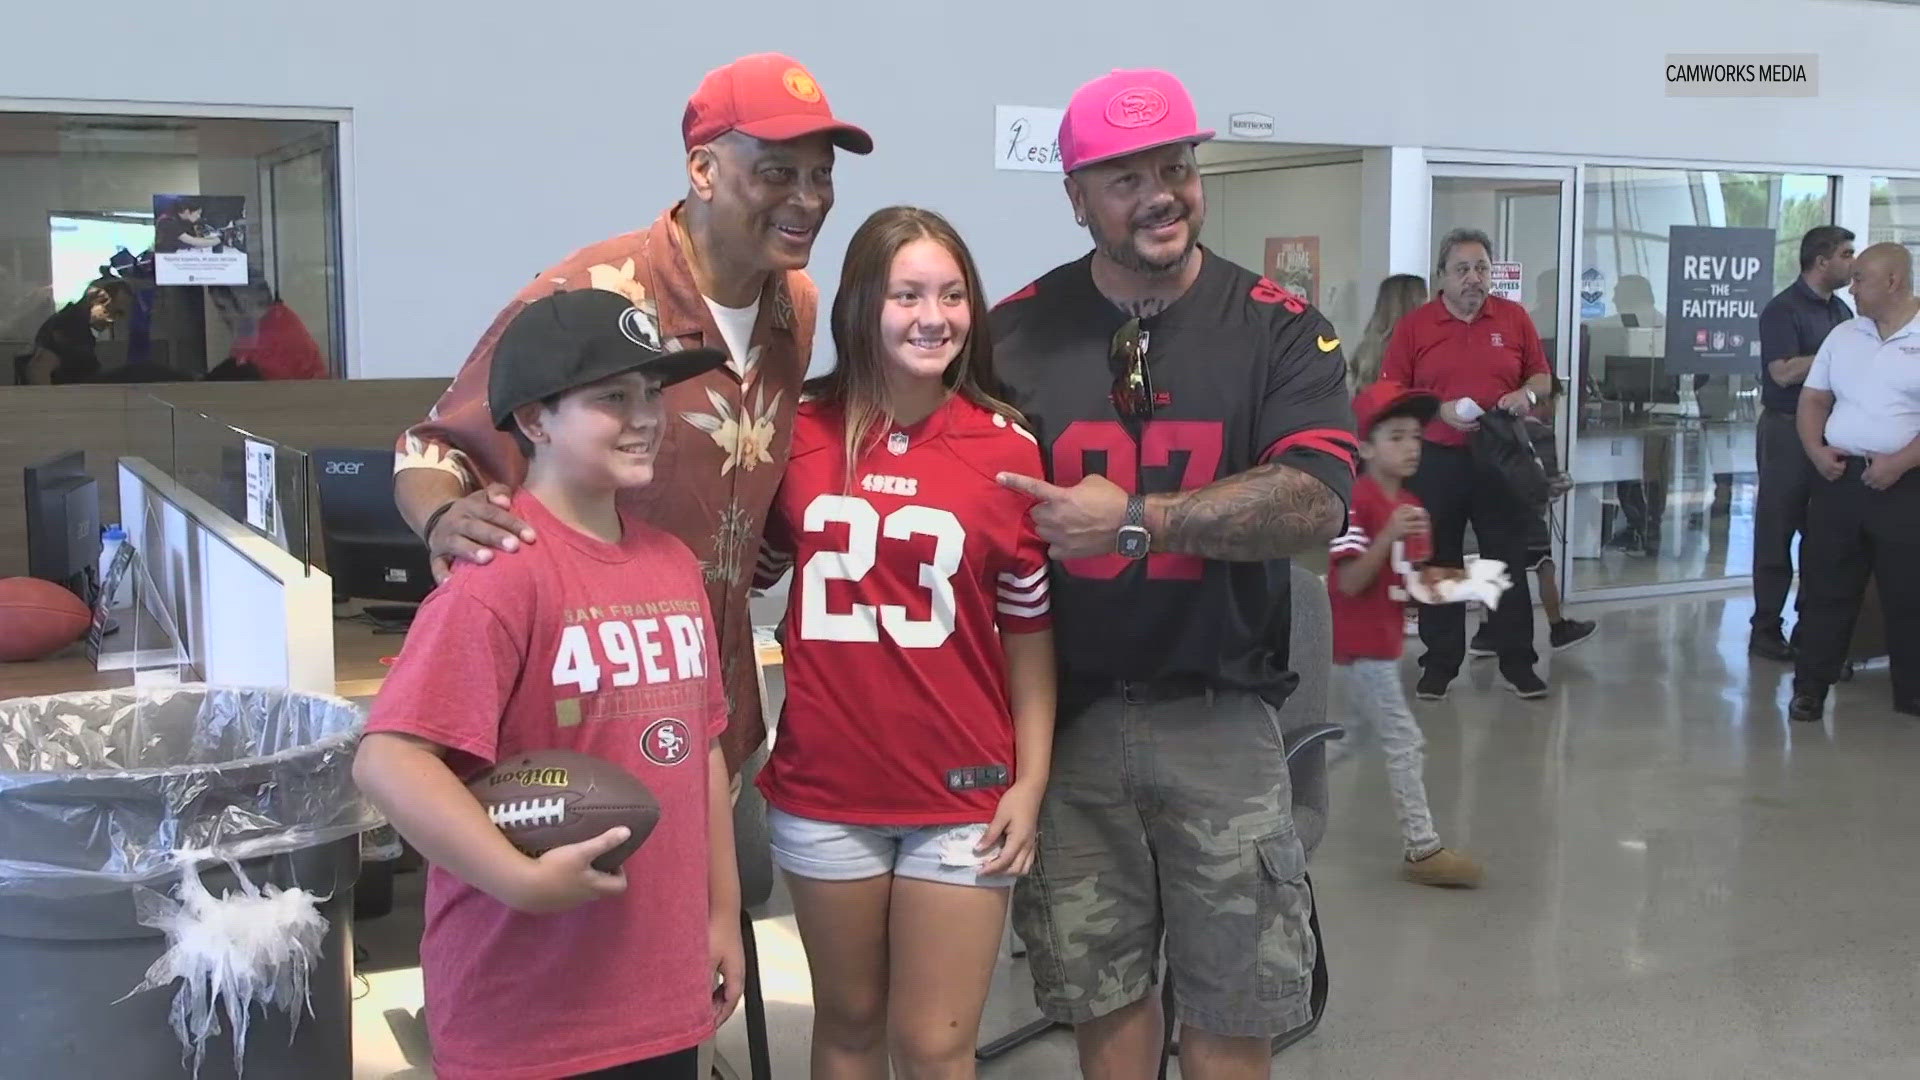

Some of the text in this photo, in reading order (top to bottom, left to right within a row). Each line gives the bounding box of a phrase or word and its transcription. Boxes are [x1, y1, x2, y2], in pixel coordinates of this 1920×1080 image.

[1233, 120, 1273, 130] RESTROOM
[1683, 255, 1761, 281] REV UP
[1491, 281, 1520, 291] PLOYEES
[1710, 284, 1730, 296] THE
[1681, 299, 1759, 319] FAITHFUL
[325, 461, 365, 475] acer
[861, 473, 919, 497] 49ERS
[800, 493, 967, 649] 23
[563, 600, 701, 623] SAN FRANCISCO
[657, 724, 684, 760] SF
[489, 766, 569, 788] Wilson
